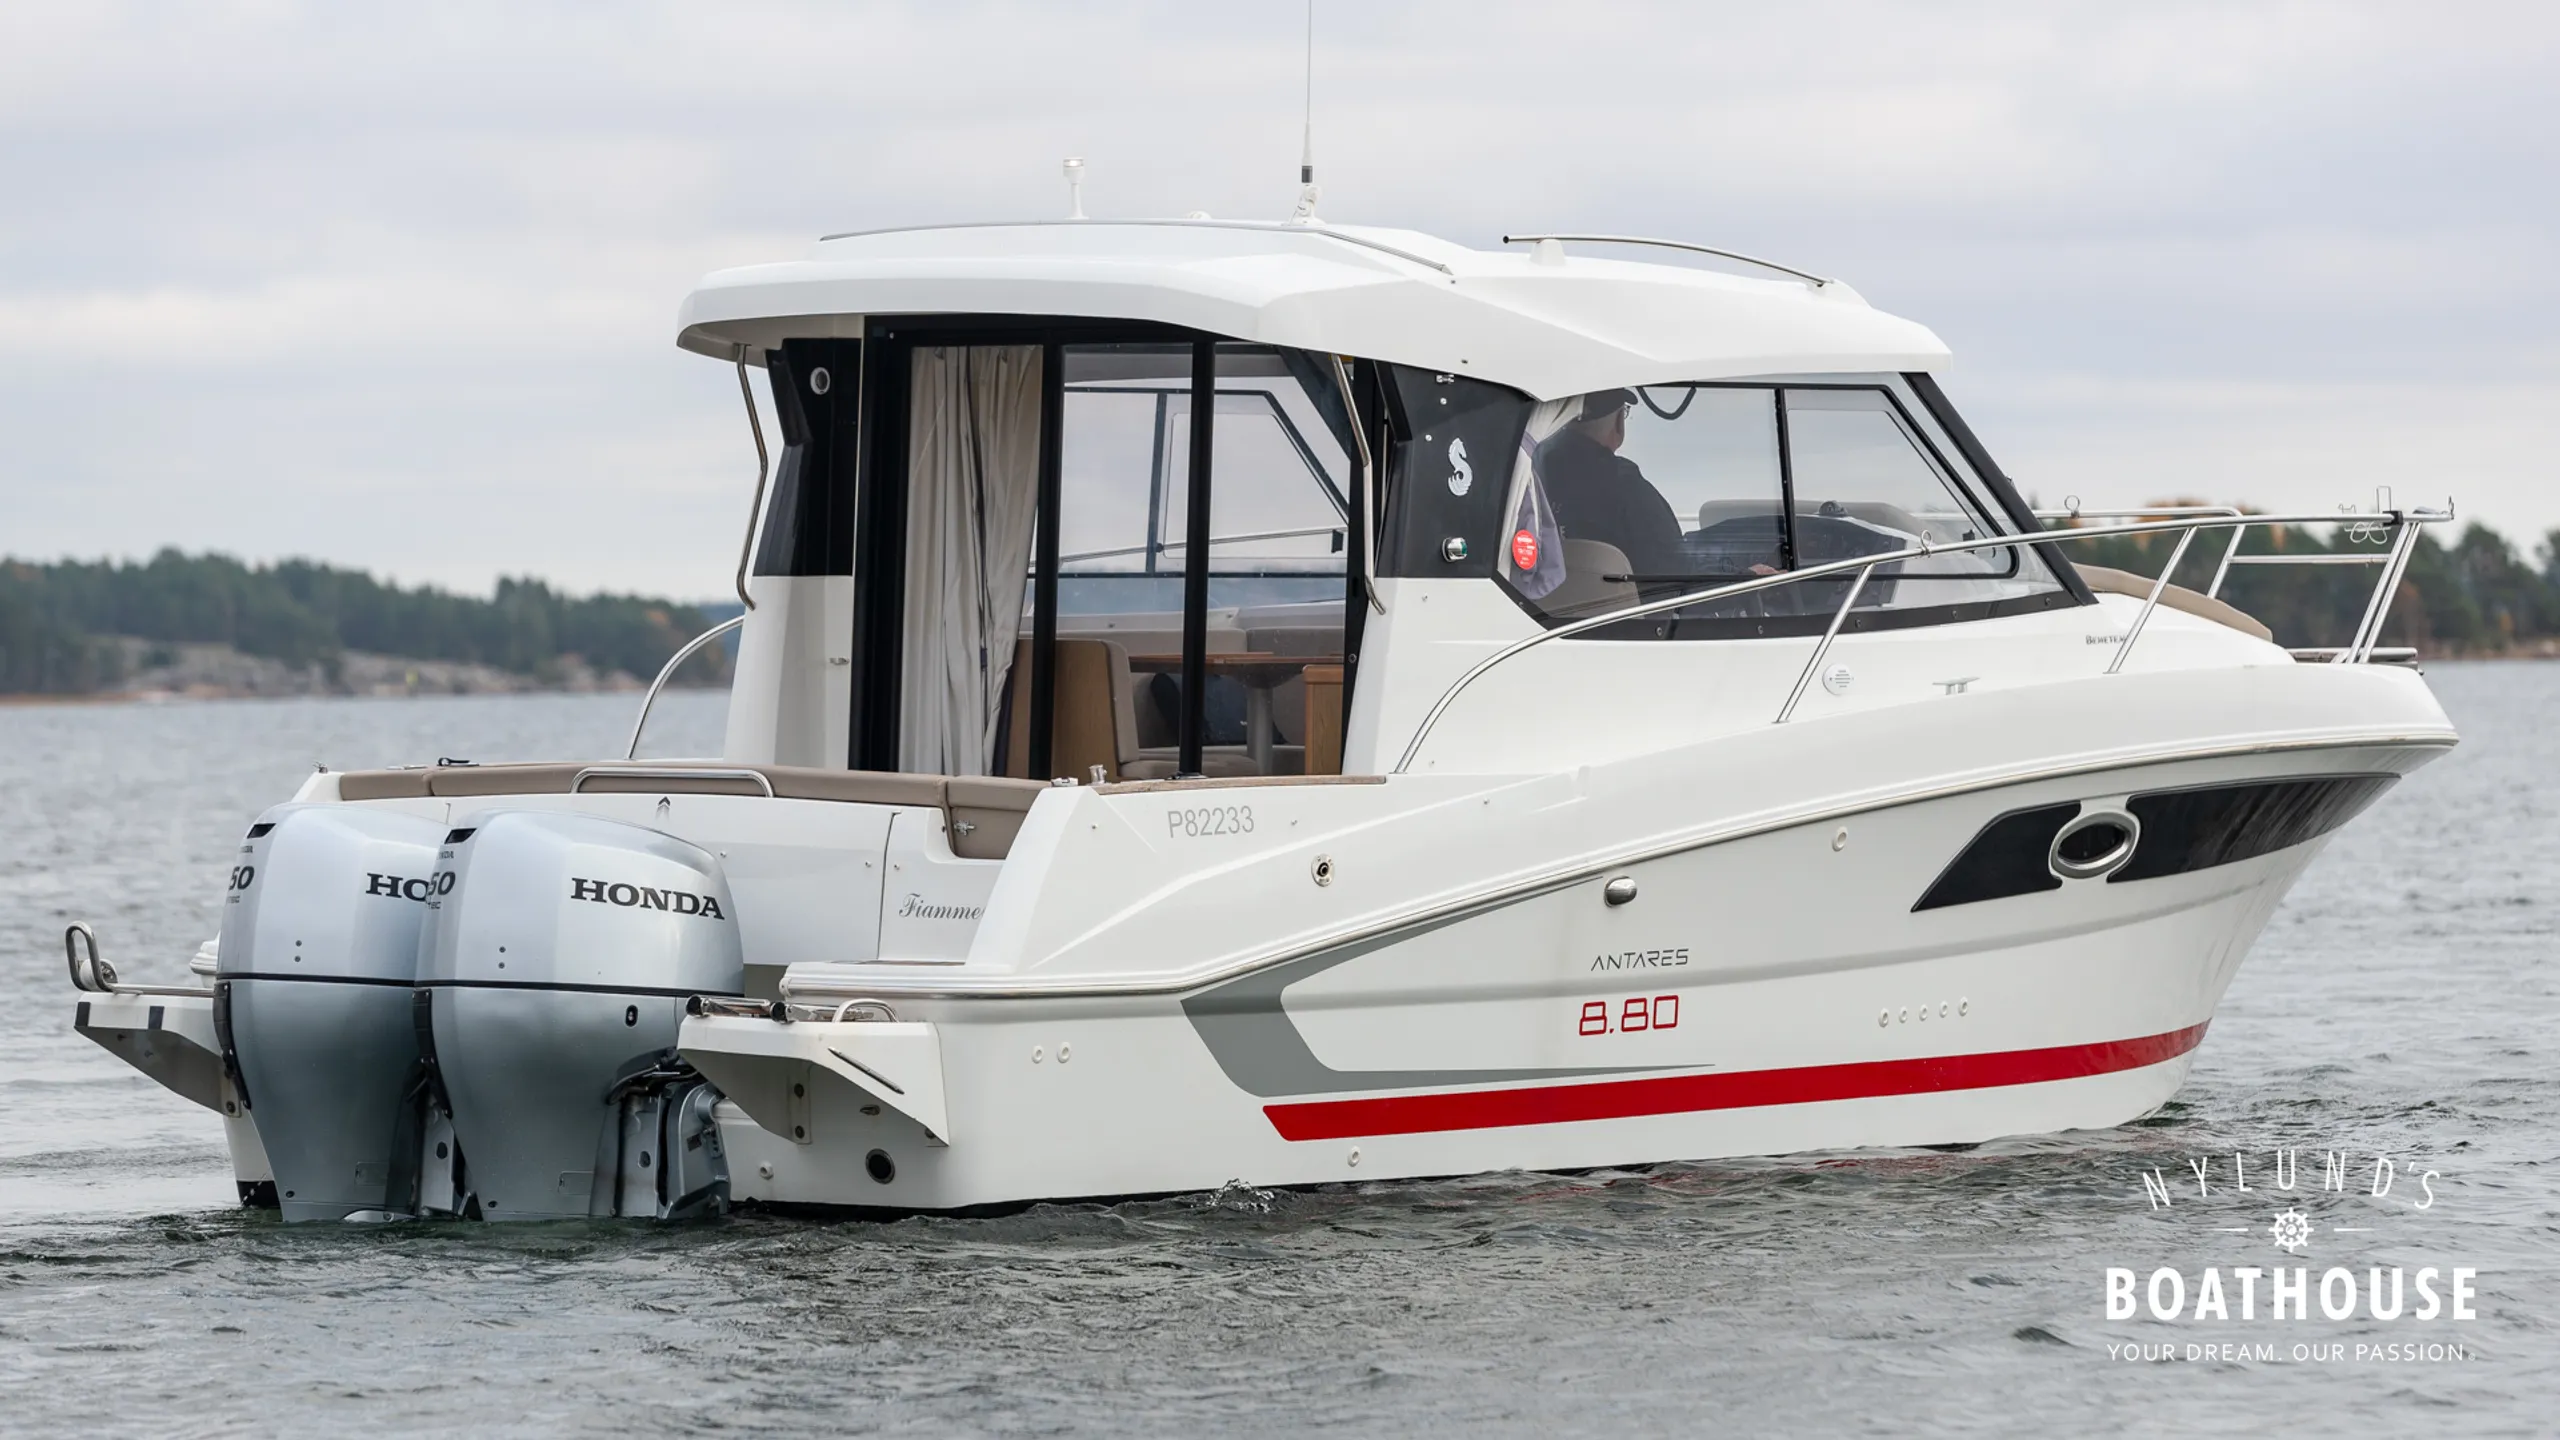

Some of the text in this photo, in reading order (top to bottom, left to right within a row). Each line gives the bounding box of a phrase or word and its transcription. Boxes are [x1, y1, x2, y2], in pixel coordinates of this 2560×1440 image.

[2085, 634, 2127, 646] BENETEA
[1167, 805, 1255, 839] P82233
[228, 865, 255, 890] 50
[427, 871, 456, 896] 50
[570, 877, 726, 921] HONDA
[898, 892, 986, 920] Fiamme
[1590, 948, 1689, 972] ANTARES
[1578, 994, 1679, 1036] 8.80
